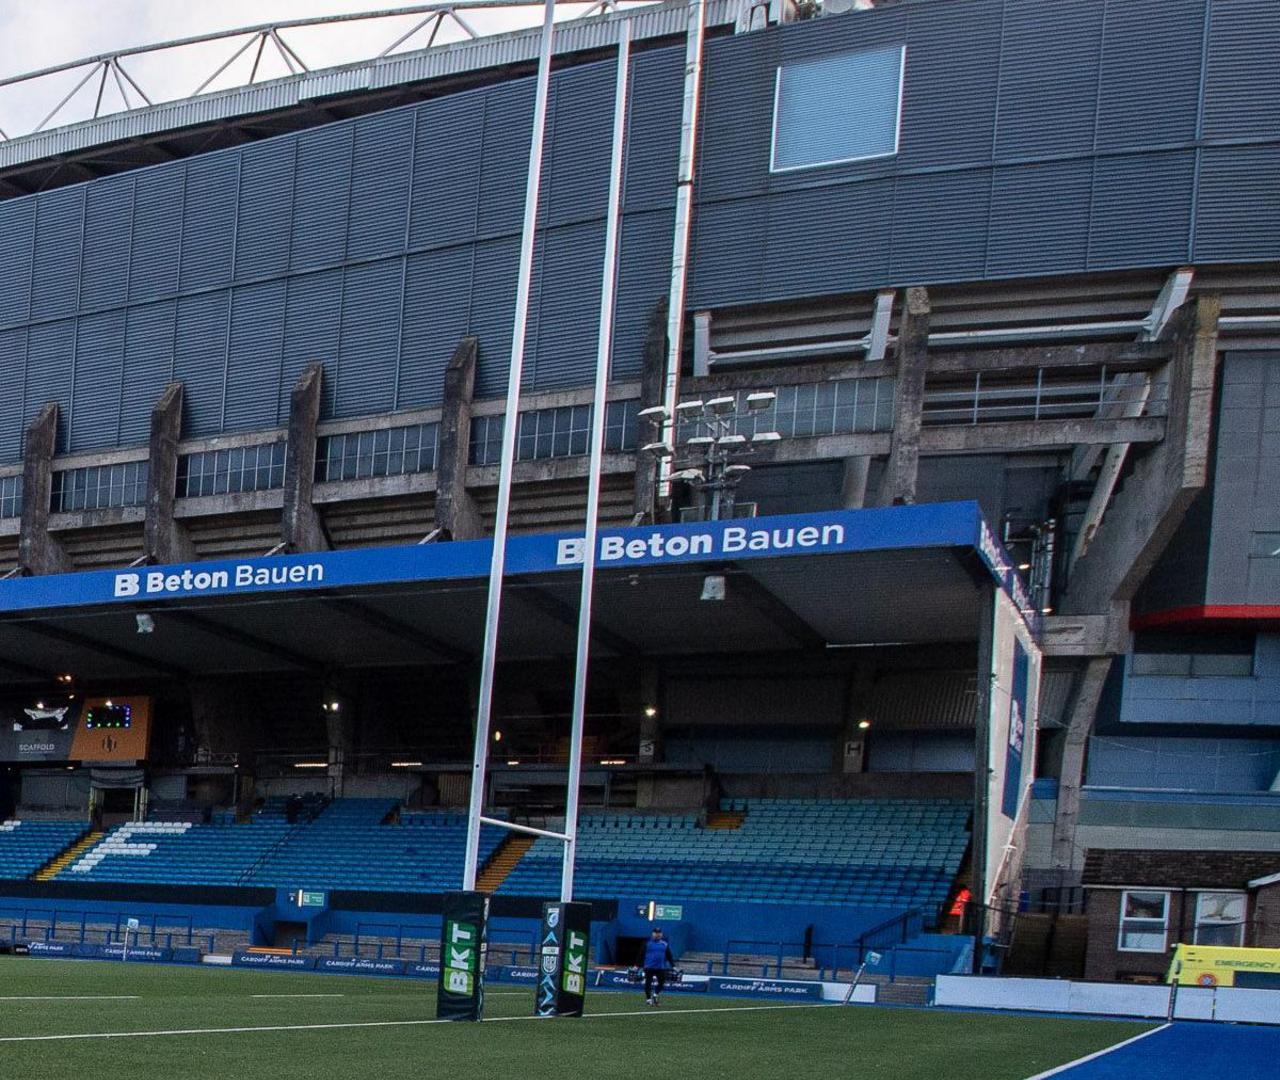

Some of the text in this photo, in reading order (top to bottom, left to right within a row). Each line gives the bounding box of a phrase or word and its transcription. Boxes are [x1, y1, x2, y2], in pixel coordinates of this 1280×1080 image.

[600, 532, 713, 560] Beton
[722, 522, 844, 552] Bauen
[146, 570, 228, 593] Beton
[235, 562, 324, 587] Bauen
[326, 959, 355, 967] CARDIFF
[375, 962, 394, 970] PARK
[449, 922, 471, 993] BKT
[566, 931, 584, 993] BKT
[720, 983, 757, 992] CARDIFF
[758, 985, 783, 993] ARMS
